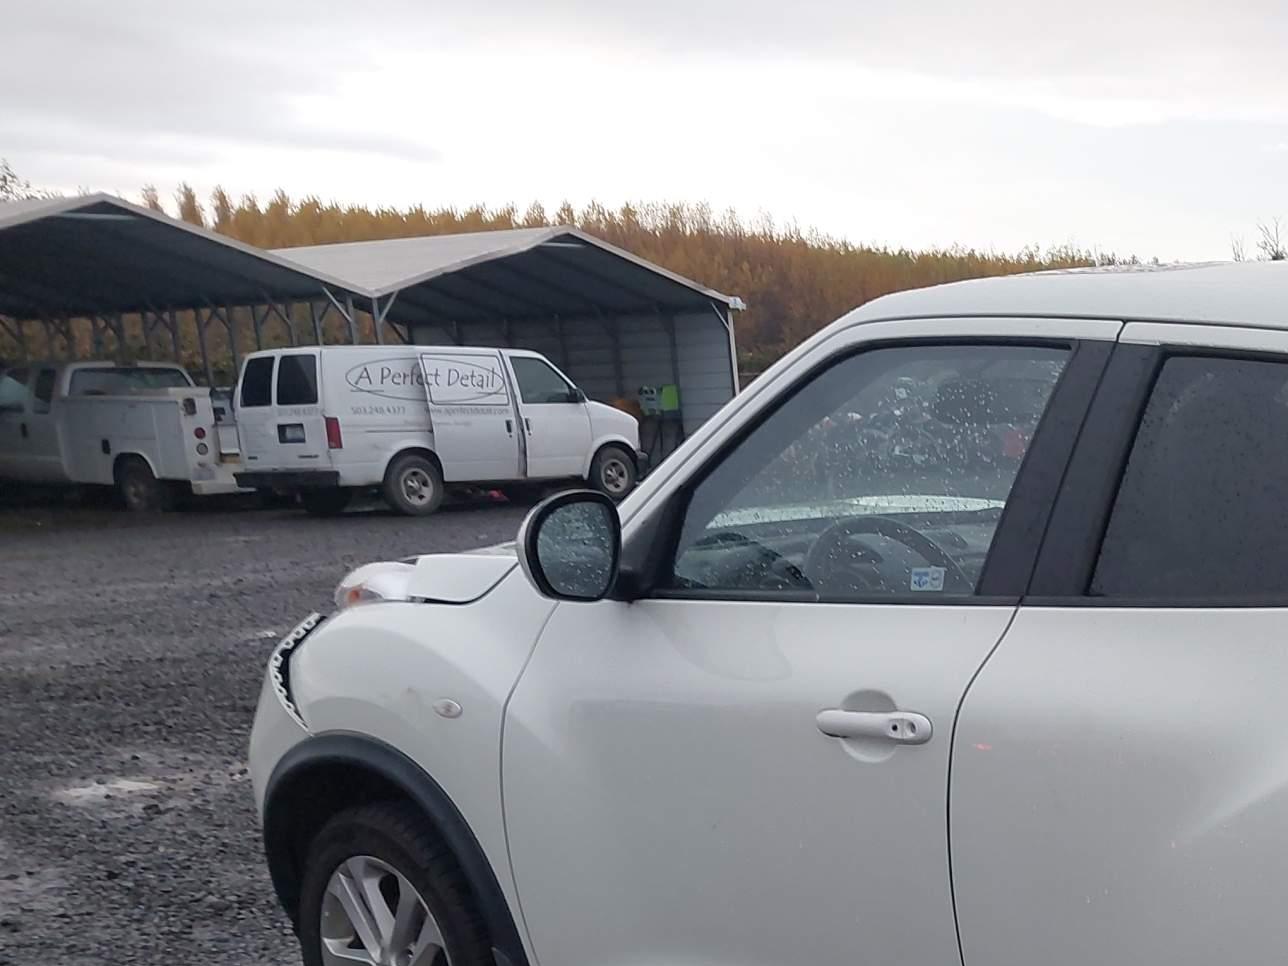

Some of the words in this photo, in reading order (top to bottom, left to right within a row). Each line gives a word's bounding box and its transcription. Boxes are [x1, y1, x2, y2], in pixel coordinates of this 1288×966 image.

[354, 366, 373, 386] A
[380, 364, 440, 387] Perfect
[447, 367, 496, 390] Detail
